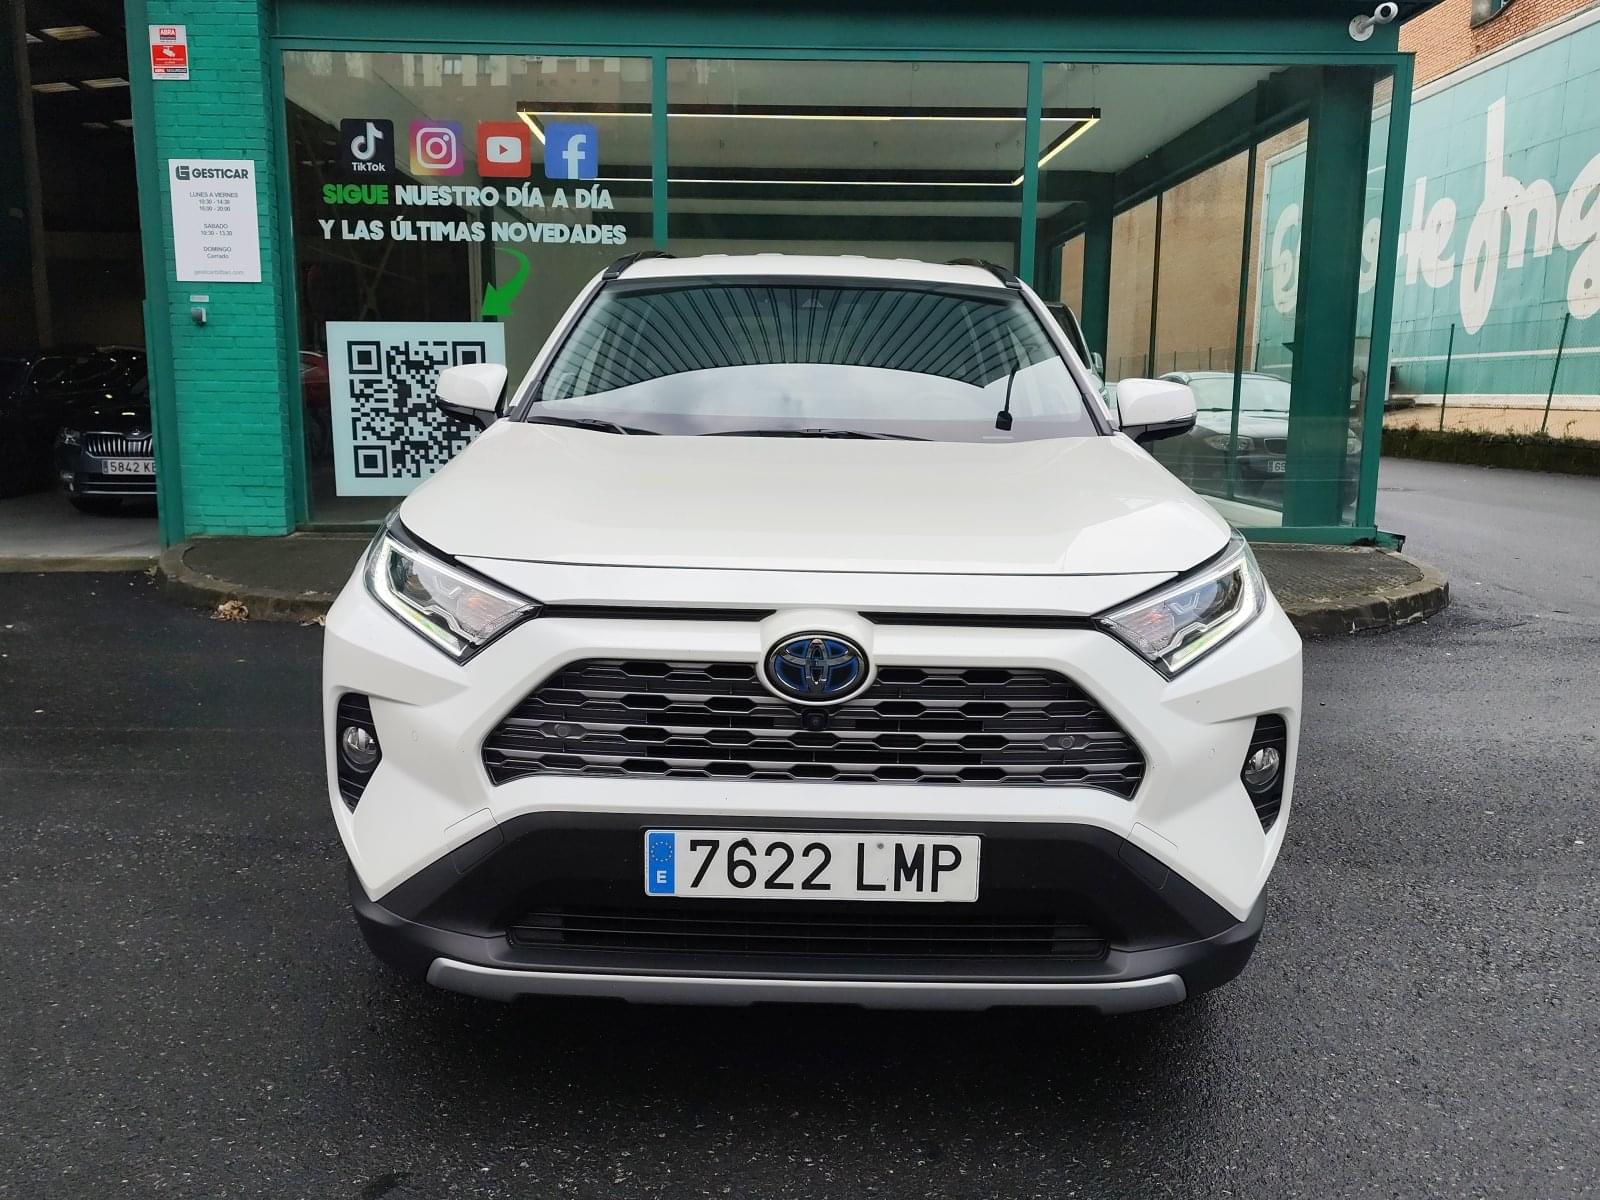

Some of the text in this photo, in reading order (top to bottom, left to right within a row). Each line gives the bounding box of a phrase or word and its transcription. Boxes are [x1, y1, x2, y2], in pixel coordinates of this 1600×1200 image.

[192, 168, 249, 180] GESTICAR
[352, 161, 386, 172] TikTok
[322, 181, 615, 211] SIGUE NUESTRO DÍA A DÍA
[318, 215, 628, 246] Y LAS ÚLTIMAS NOVEDADES
[110, 461, 140, 473] 5842
[656, 838, 962, 893] E 7622 LMP
